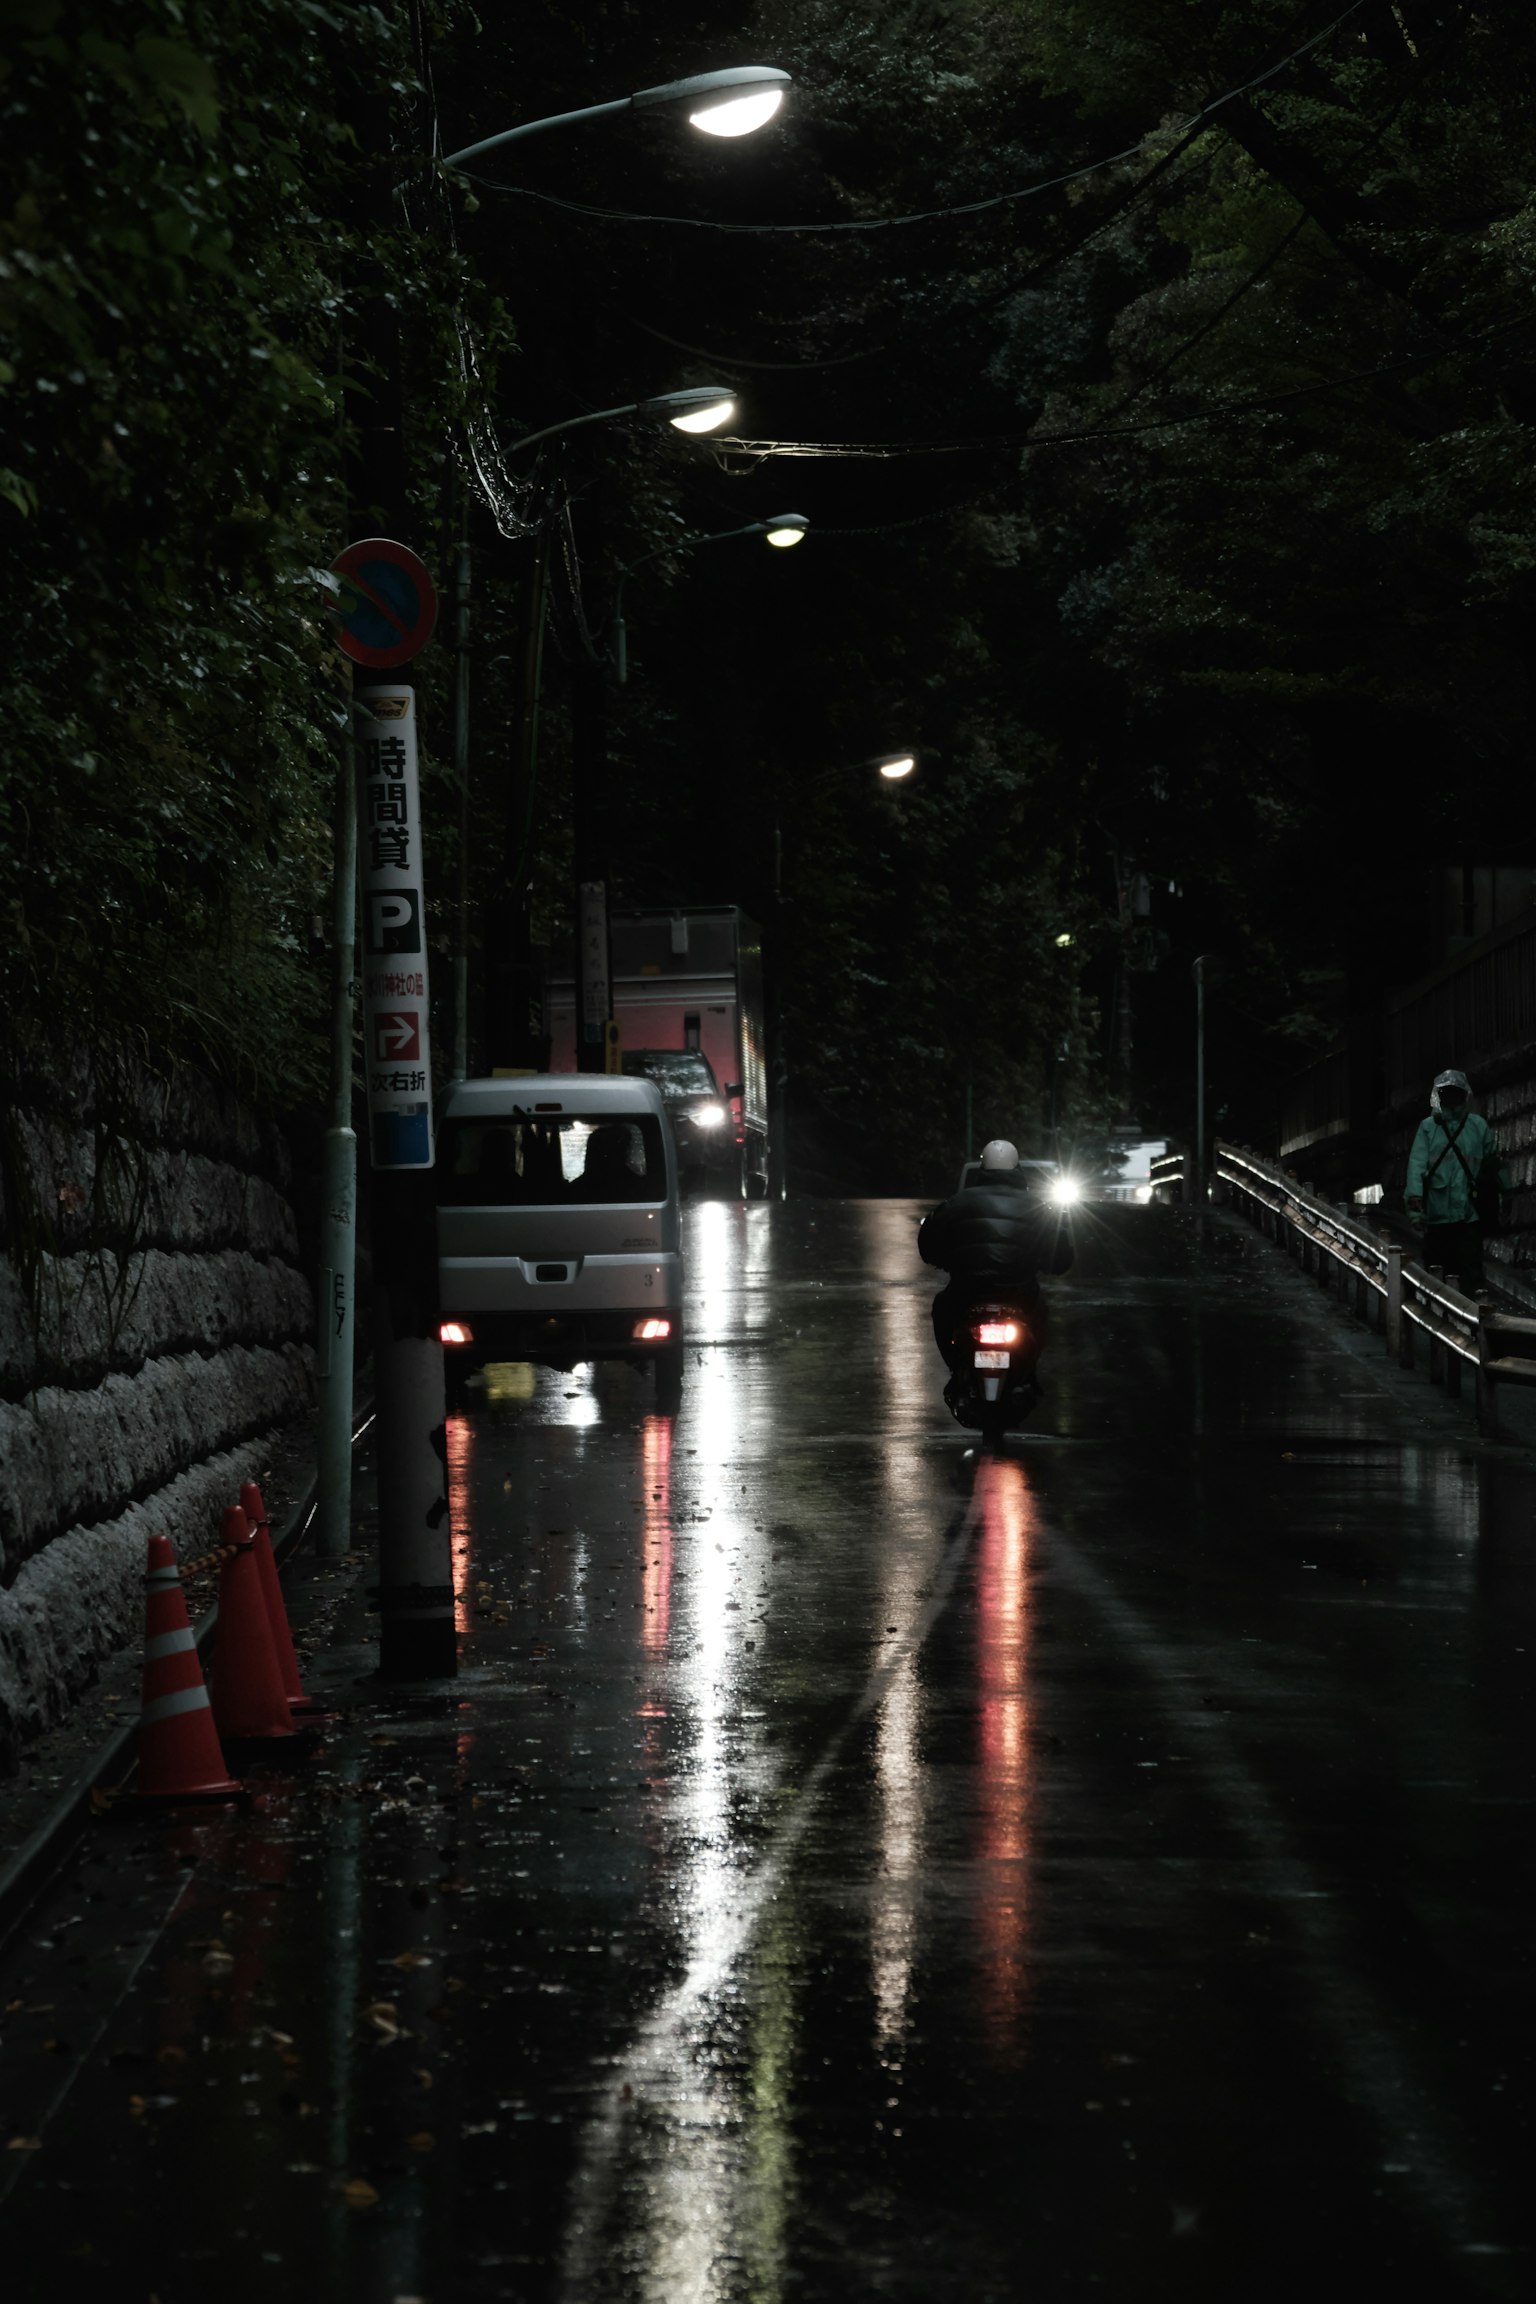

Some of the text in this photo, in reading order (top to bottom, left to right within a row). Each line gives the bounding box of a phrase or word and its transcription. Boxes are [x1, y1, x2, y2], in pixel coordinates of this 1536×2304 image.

[367, 736, 410, 871] 時間貸
[371, 895, 413, 948] P
[371, 1071, 425, 1091] 次右折
[644, 1273, 653, 1287] 3
